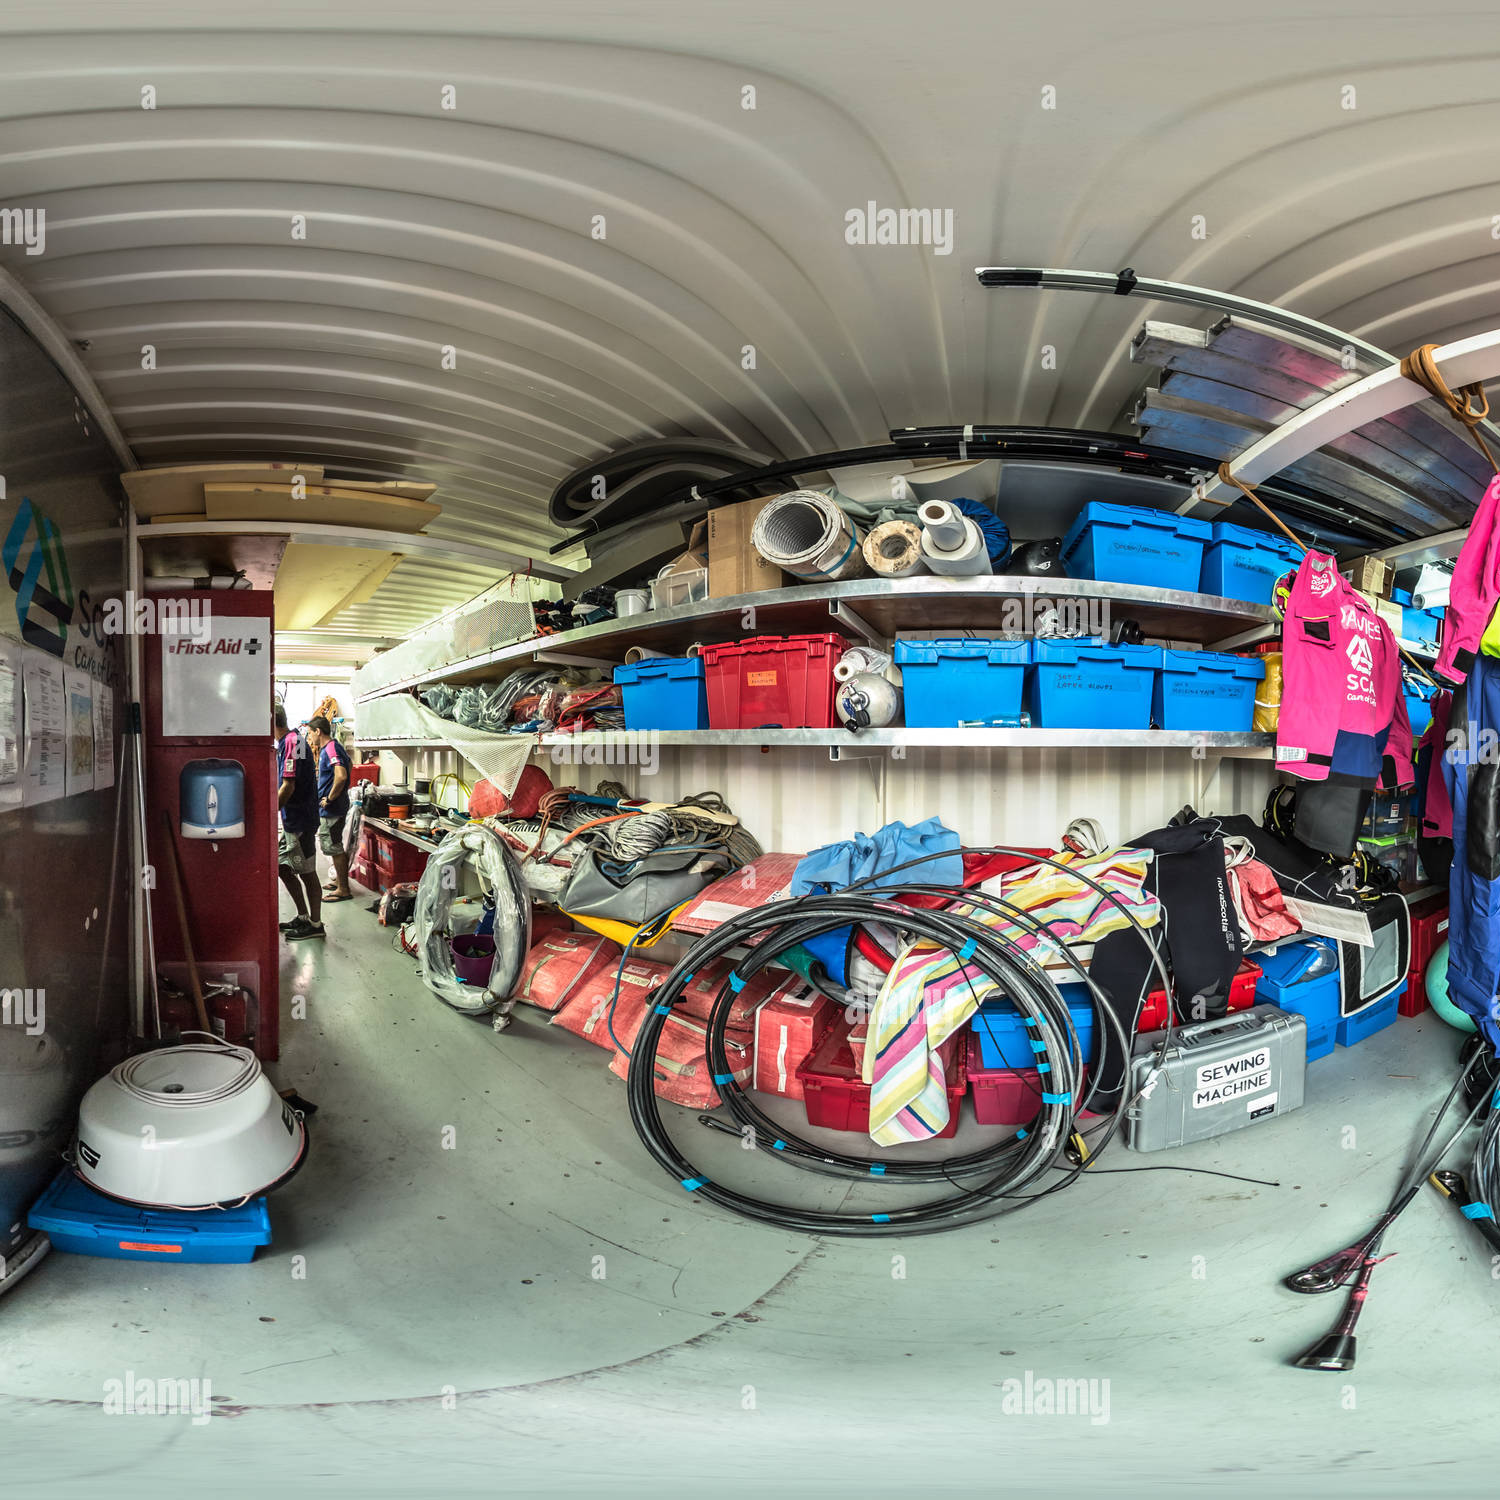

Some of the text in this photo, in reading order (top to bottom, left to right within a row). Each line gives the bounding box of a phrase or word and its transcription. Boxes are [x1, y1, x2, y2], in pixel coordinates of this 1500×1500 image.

[176, 638, 242, 654] First Aid
[1347, 674, 1375, 697] SCA
[1202, 1054, 1265, 1082] SEWING
[1197, 1073, 1268, 1104] MACHINE
